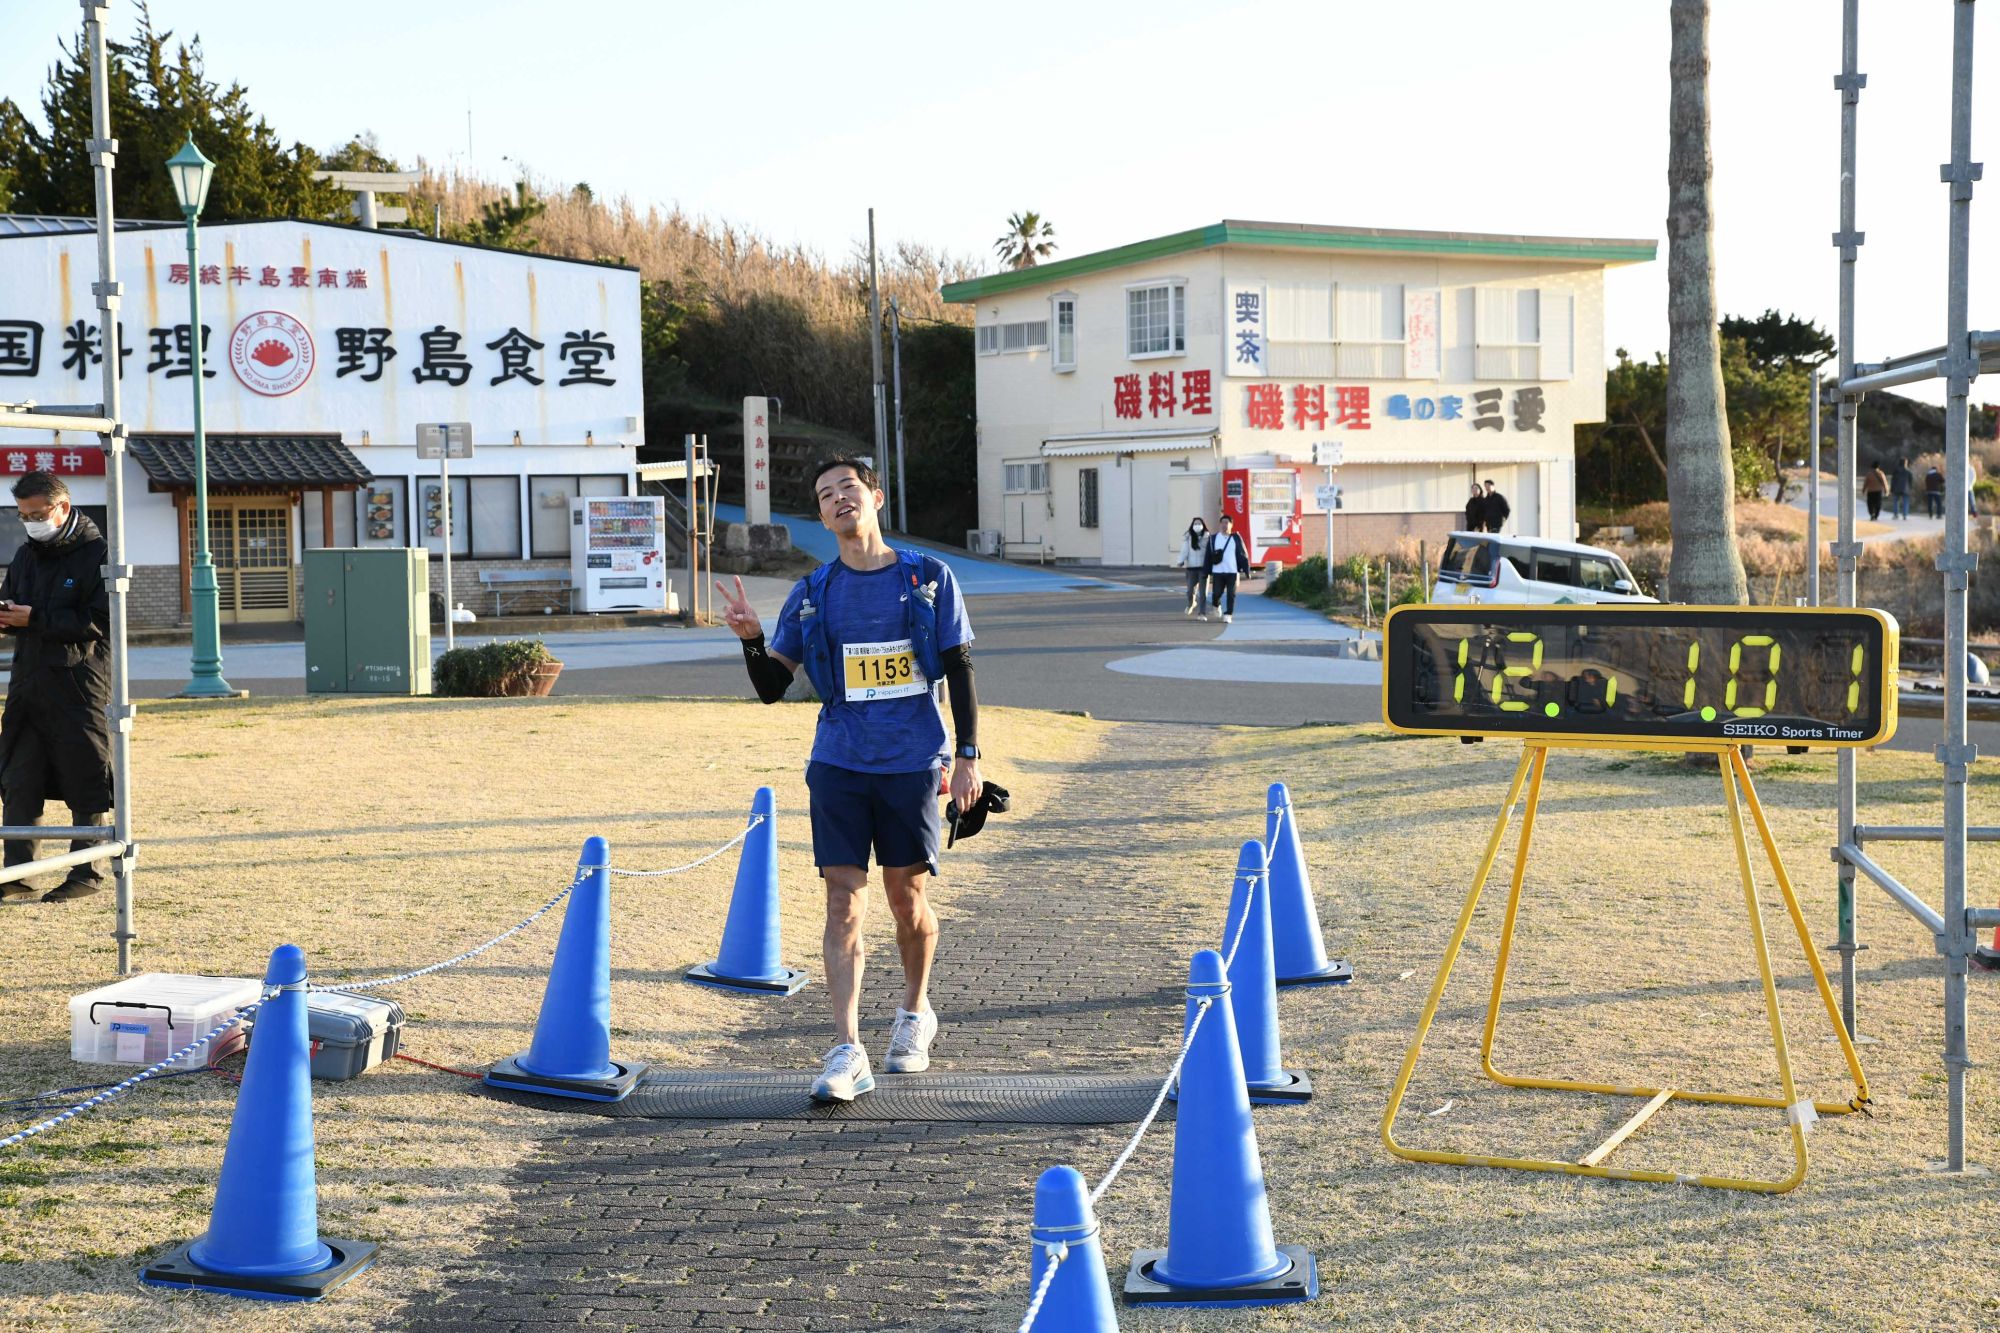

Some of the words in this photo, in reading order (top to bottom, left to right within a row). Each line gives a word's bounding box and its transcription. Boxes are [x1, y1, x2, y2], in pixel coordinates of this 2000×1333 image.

[168, 263, 368, 289] 房総半島最南端
[1235, 291, 1260, 364] 喫茶
[334, 325, 616, 387] 野島食堂
[243, 368, 270, 390] NOJIMA
[271, 367, 305, 391] SHOKUDO
[1114, 369, 1212, 420] 磯料理
[1247, 383, 1371, 431] 磯料理
[7, 452, 83, 472] 営業中
[858, 656, 911, 681] 1153
[1723, 724, 1777, 736] SEIKO
[1781, 727, 1823, 739] Sports
[1826, 728, 1864, 739] Timer
